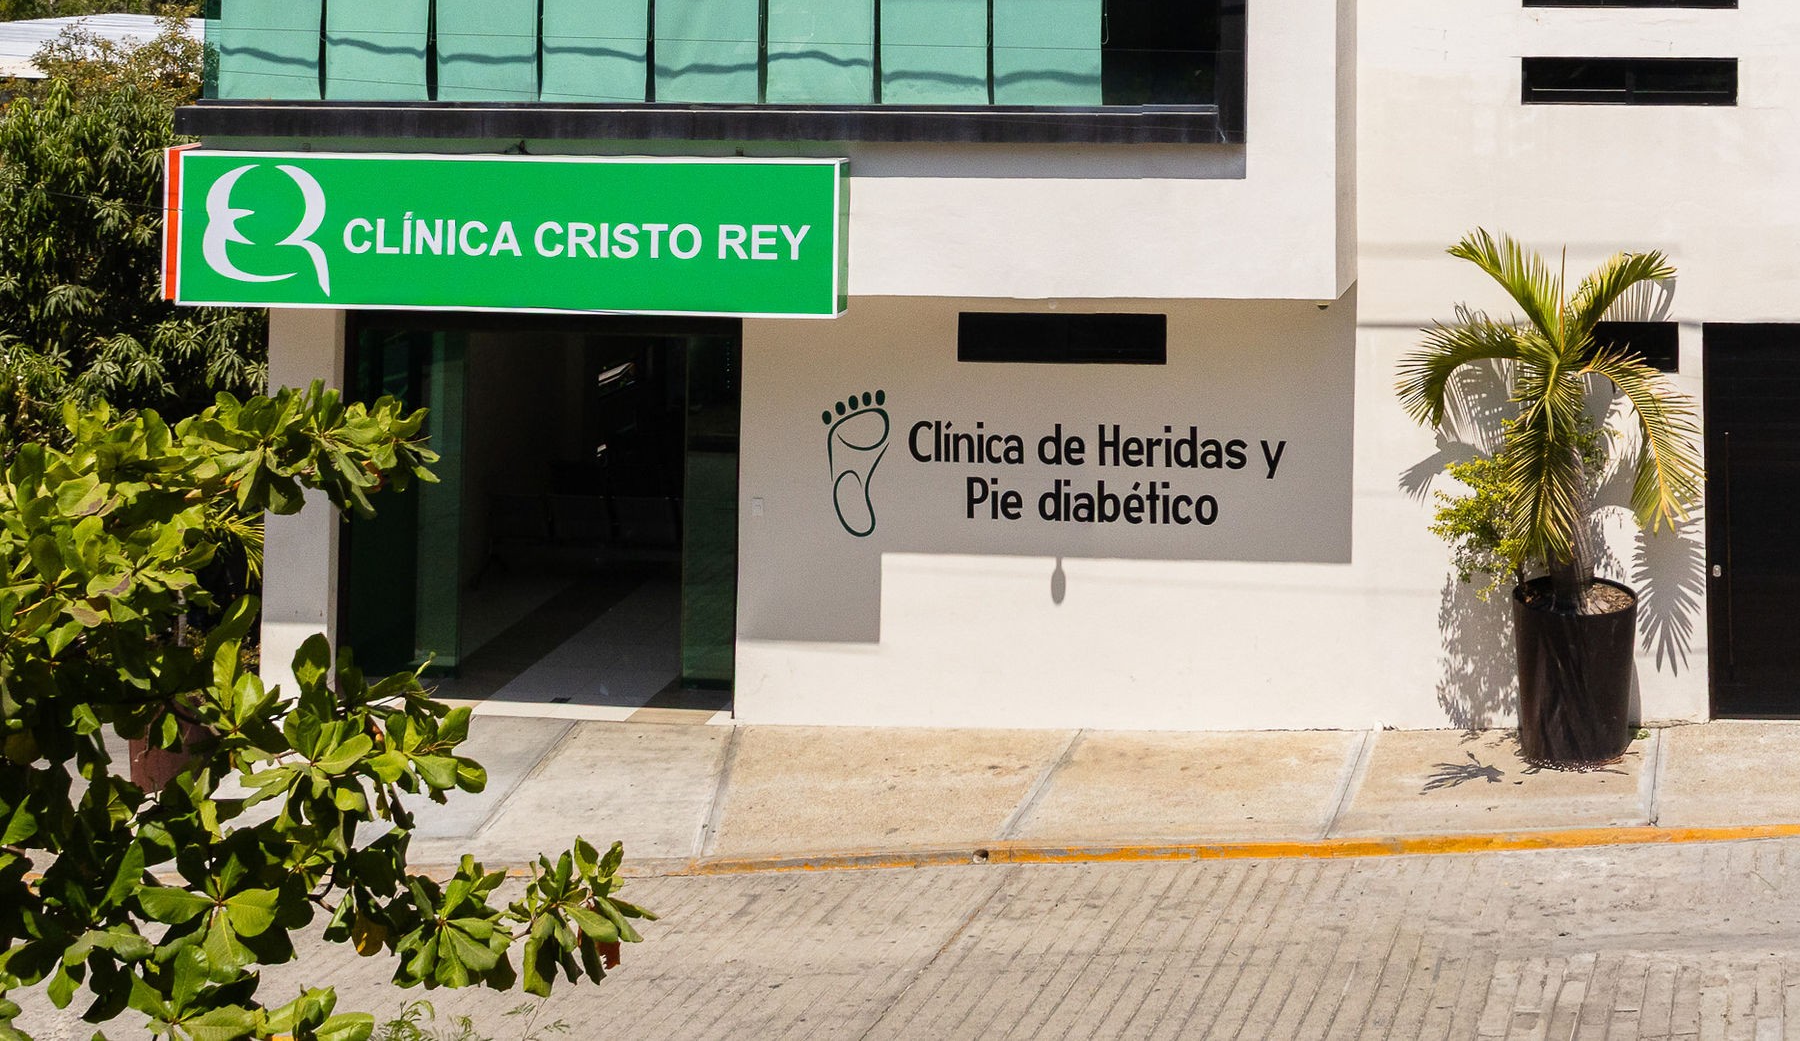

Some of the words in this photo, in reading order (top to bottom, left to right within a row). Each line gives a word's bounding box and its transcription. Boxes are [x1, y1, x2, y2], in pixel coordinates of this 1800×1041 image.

[343, 211, 521, 258] CLÍNICA
[534, 221, 702, 260] CRISTO
[718, 224, 811, 261] REY
[908, 420, 1024, 465] Clínica
[1037, 423, 1086, 466] de
[1098, 424, 1248, 470] Heridas
[1259, 439, 1288, 480] y
[966, 476, 1023, 521] Pie
[1038, 479, 1219, 526] diabético
